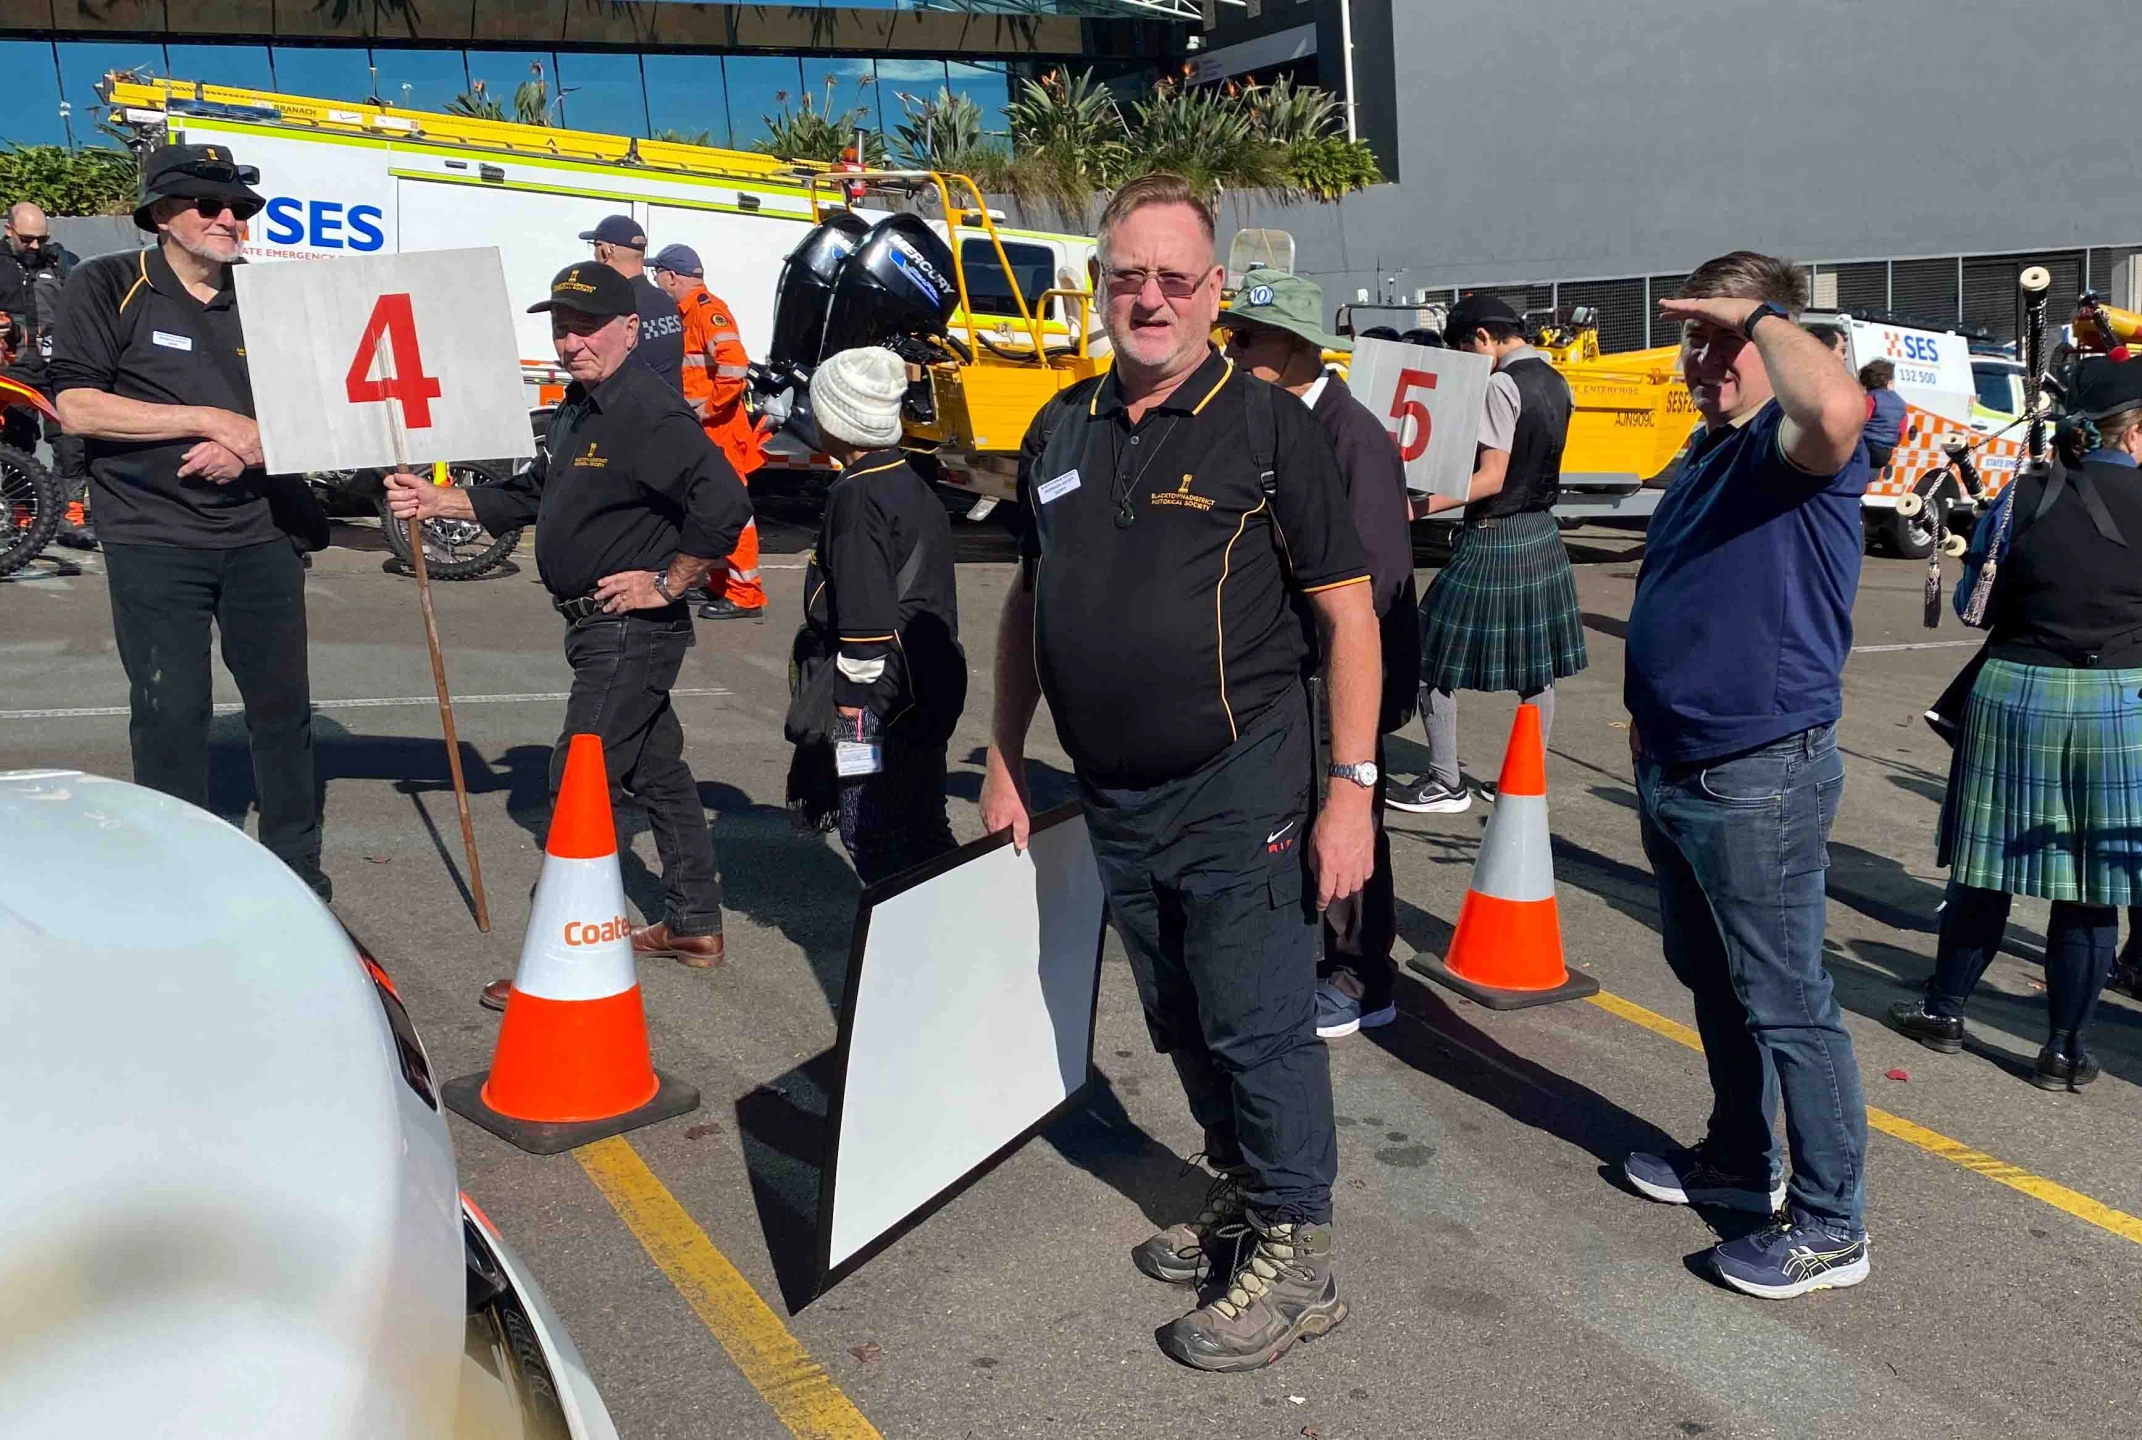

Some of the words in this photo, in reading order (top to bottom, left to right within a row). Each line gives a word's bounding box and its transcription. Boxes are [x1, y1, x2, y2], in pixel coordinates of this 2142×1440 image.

[273, 99, 316, 116] BRANACH
[266, 197, 384, 252] SES
[240, 247, 262, 256] ATE
[888, 233, 955, 294] MERCURY
[1252, 288, 1267, 303] 10
[658, 314, 682, 335] SES
[346, 293, 441, 429] 4
[1904, 335, 1939, 362] SES
[1900, 369, 1916, 382] 132
[1919, 372, 1936, 385] 500
[1387, 368, 1437, 462] 5
[564, 916, 630, 946] Coate
